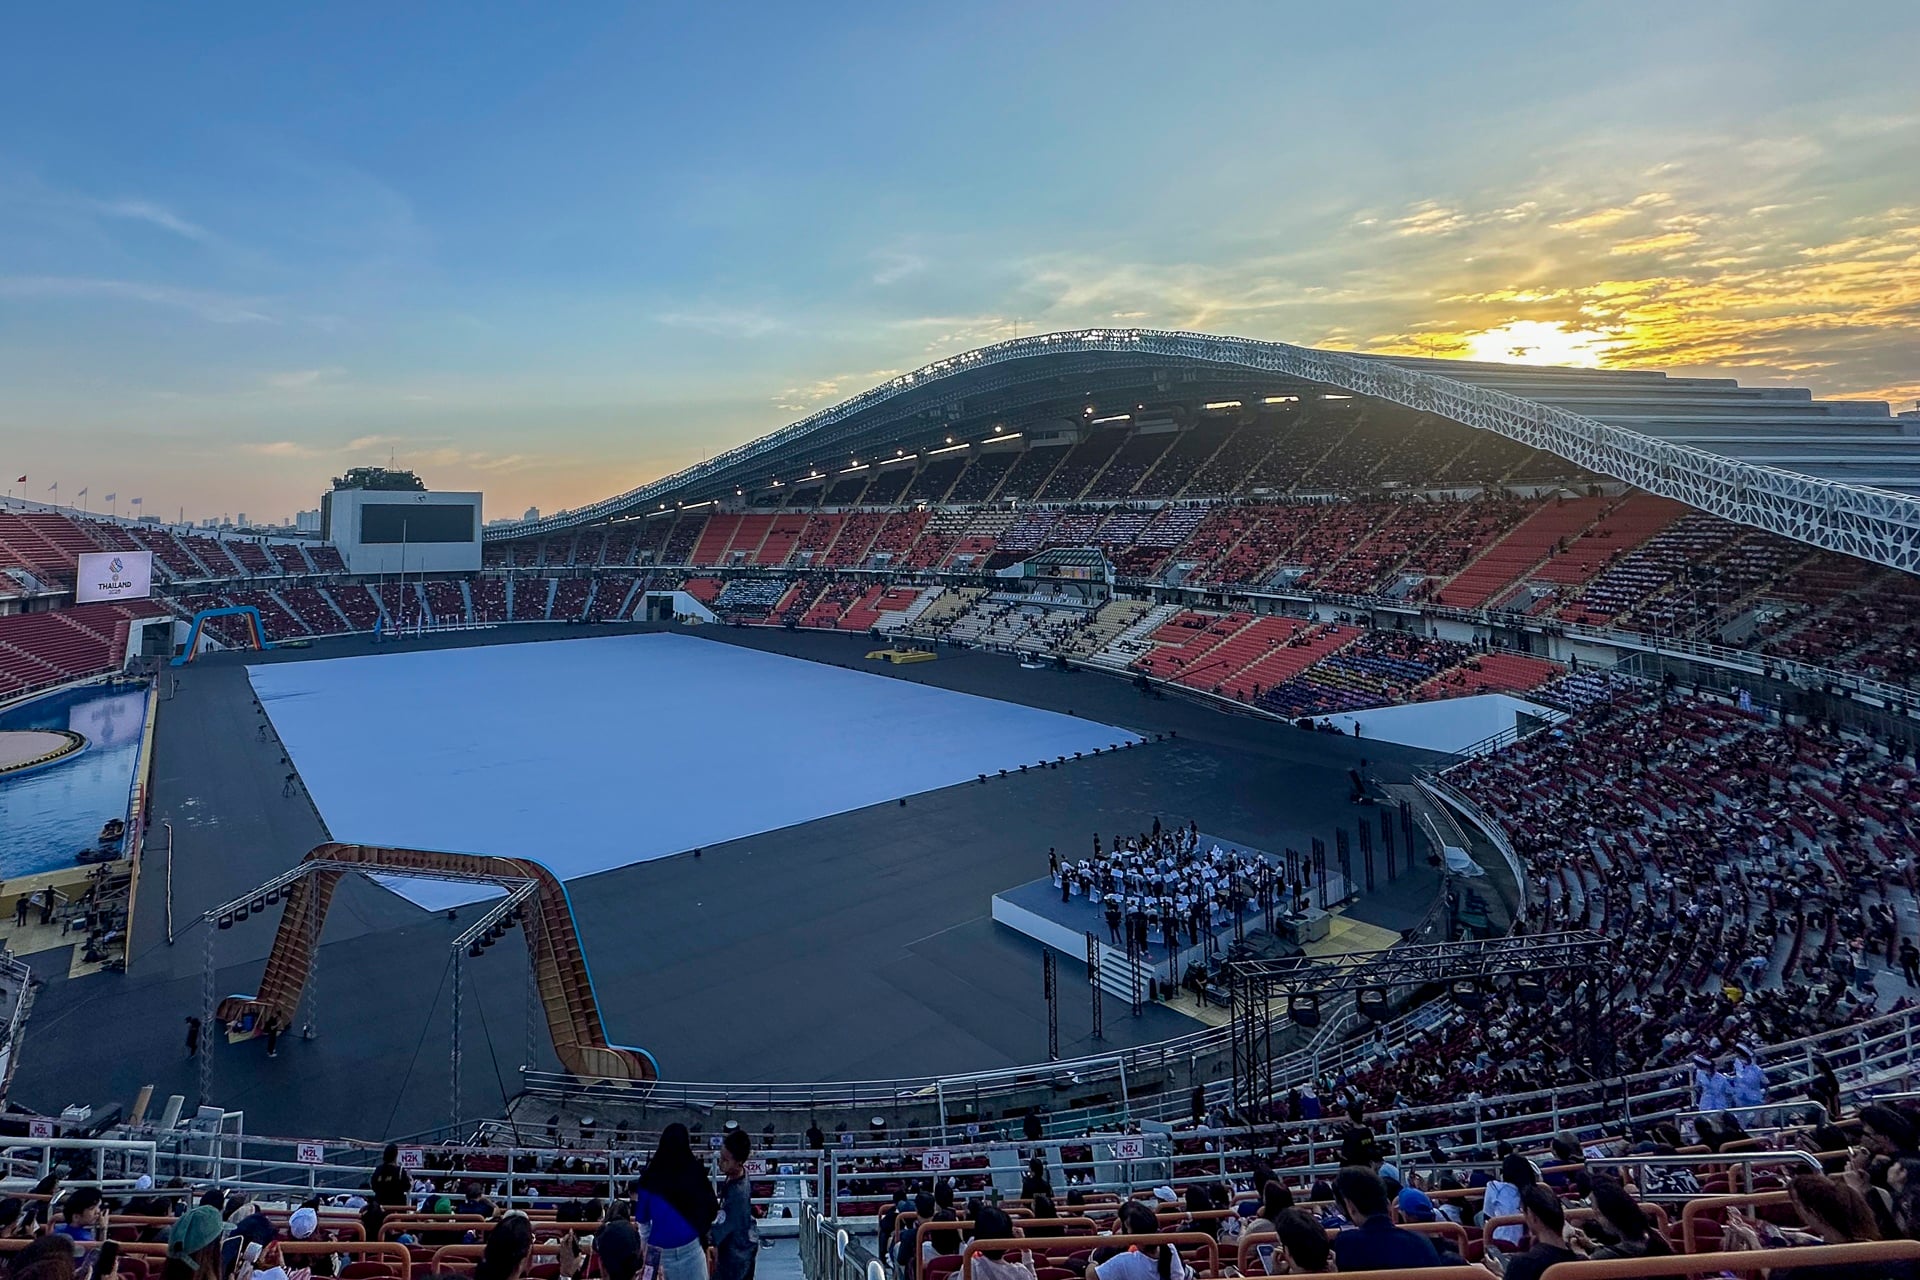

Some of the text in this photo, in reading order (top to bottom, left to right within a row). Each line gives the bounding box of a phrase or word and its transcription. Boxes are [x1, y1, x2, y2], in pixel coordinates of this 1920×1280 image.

[97, 581, 132, 590] THAILAND
[34, 1126, 48, 1135] N2L
[302, 1148, 318, 1158] N2L
[1122, 1144, 1138, 1153] N2J
[401, 1154, 418, 1163] N2K
[927, 1156, 944, 1165] N2J
